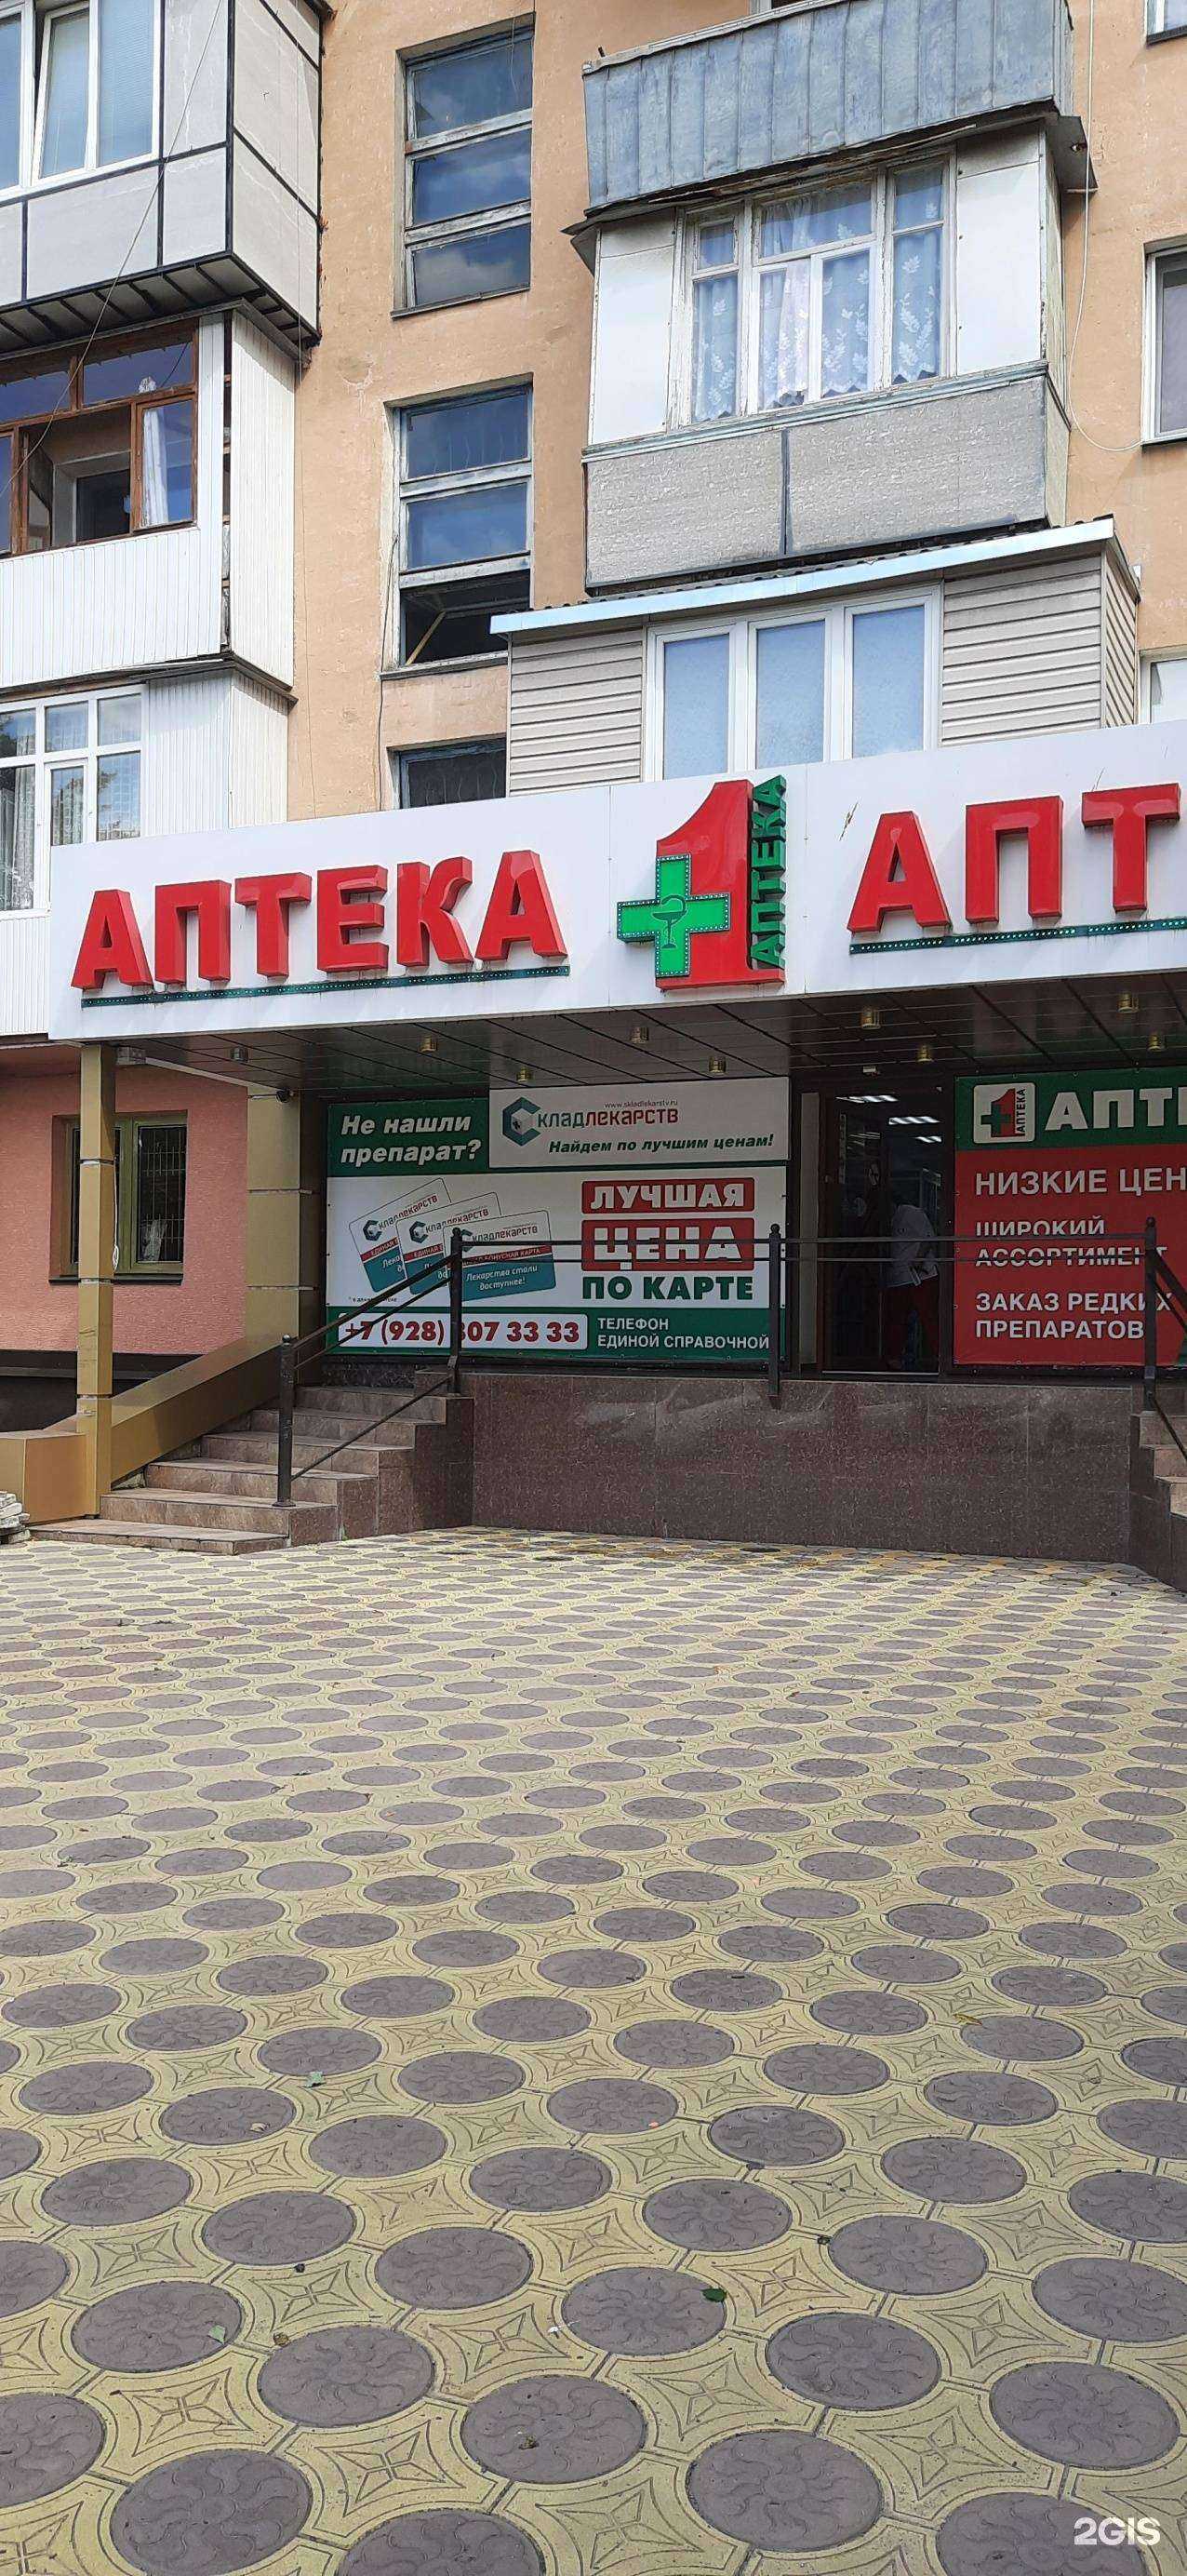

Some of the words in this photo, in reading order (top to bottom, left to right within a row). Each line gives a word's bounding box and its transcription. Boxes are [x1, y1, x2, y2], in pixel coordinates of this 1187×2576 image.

[751, 775, 786, 970] АПТЕКА
[72, 850, 568, 991] АПТЕКА
[1017, 1088, 1026, 1137] АПТЕКА
[1045, 1086, 1187, 1131] АПТ
[341, 1116, 375, 1134] Не
[383, 1116, 471, 1134] нашли
[341, 1139, 481, 1167] препарат?
[549, 1139, 611, 1154] Найдем
[617, 1141, 637, 1152] по
[642, 1138, 708, 1153] лучшим
[714, 1134, 774, 1150] ценам!
[977, 1169, 1107, 1195] НИЗКИЕ
[590, 1183, 745, 1210] ЛУЧШАЯ
[977, 1215, 1105, 1236] ШИРОКИЙ
[594, 1226, 742, 1270] ЦЕНА
[976, 1246, 1167, 1267] АССОРТИМЕ
[466, 1269, 510, 1281] Лекарства
[512, 1265, 538, 1275] стали
[582, 1276, 633, 1300] ПО
[644, 1276, 754, 1300] КАРТЕ
[977, 1293, 1059, 1311] ЗАКАЗ
[381, 1319, 445, 1346] (928)
[507, 1322, 539, 1342] 33
[547, 1322, 580, 1342] 33
[597, 1318, 669, 1331] ТЕЛЕФОН
[977, 1320, 1144, 1339] ПРЕПАРАТОВ
[598, 1335, 660, 1348] ЕДИНОЙ
[664, 1335, 770, 1349] СПРАВОЧНОЙ
